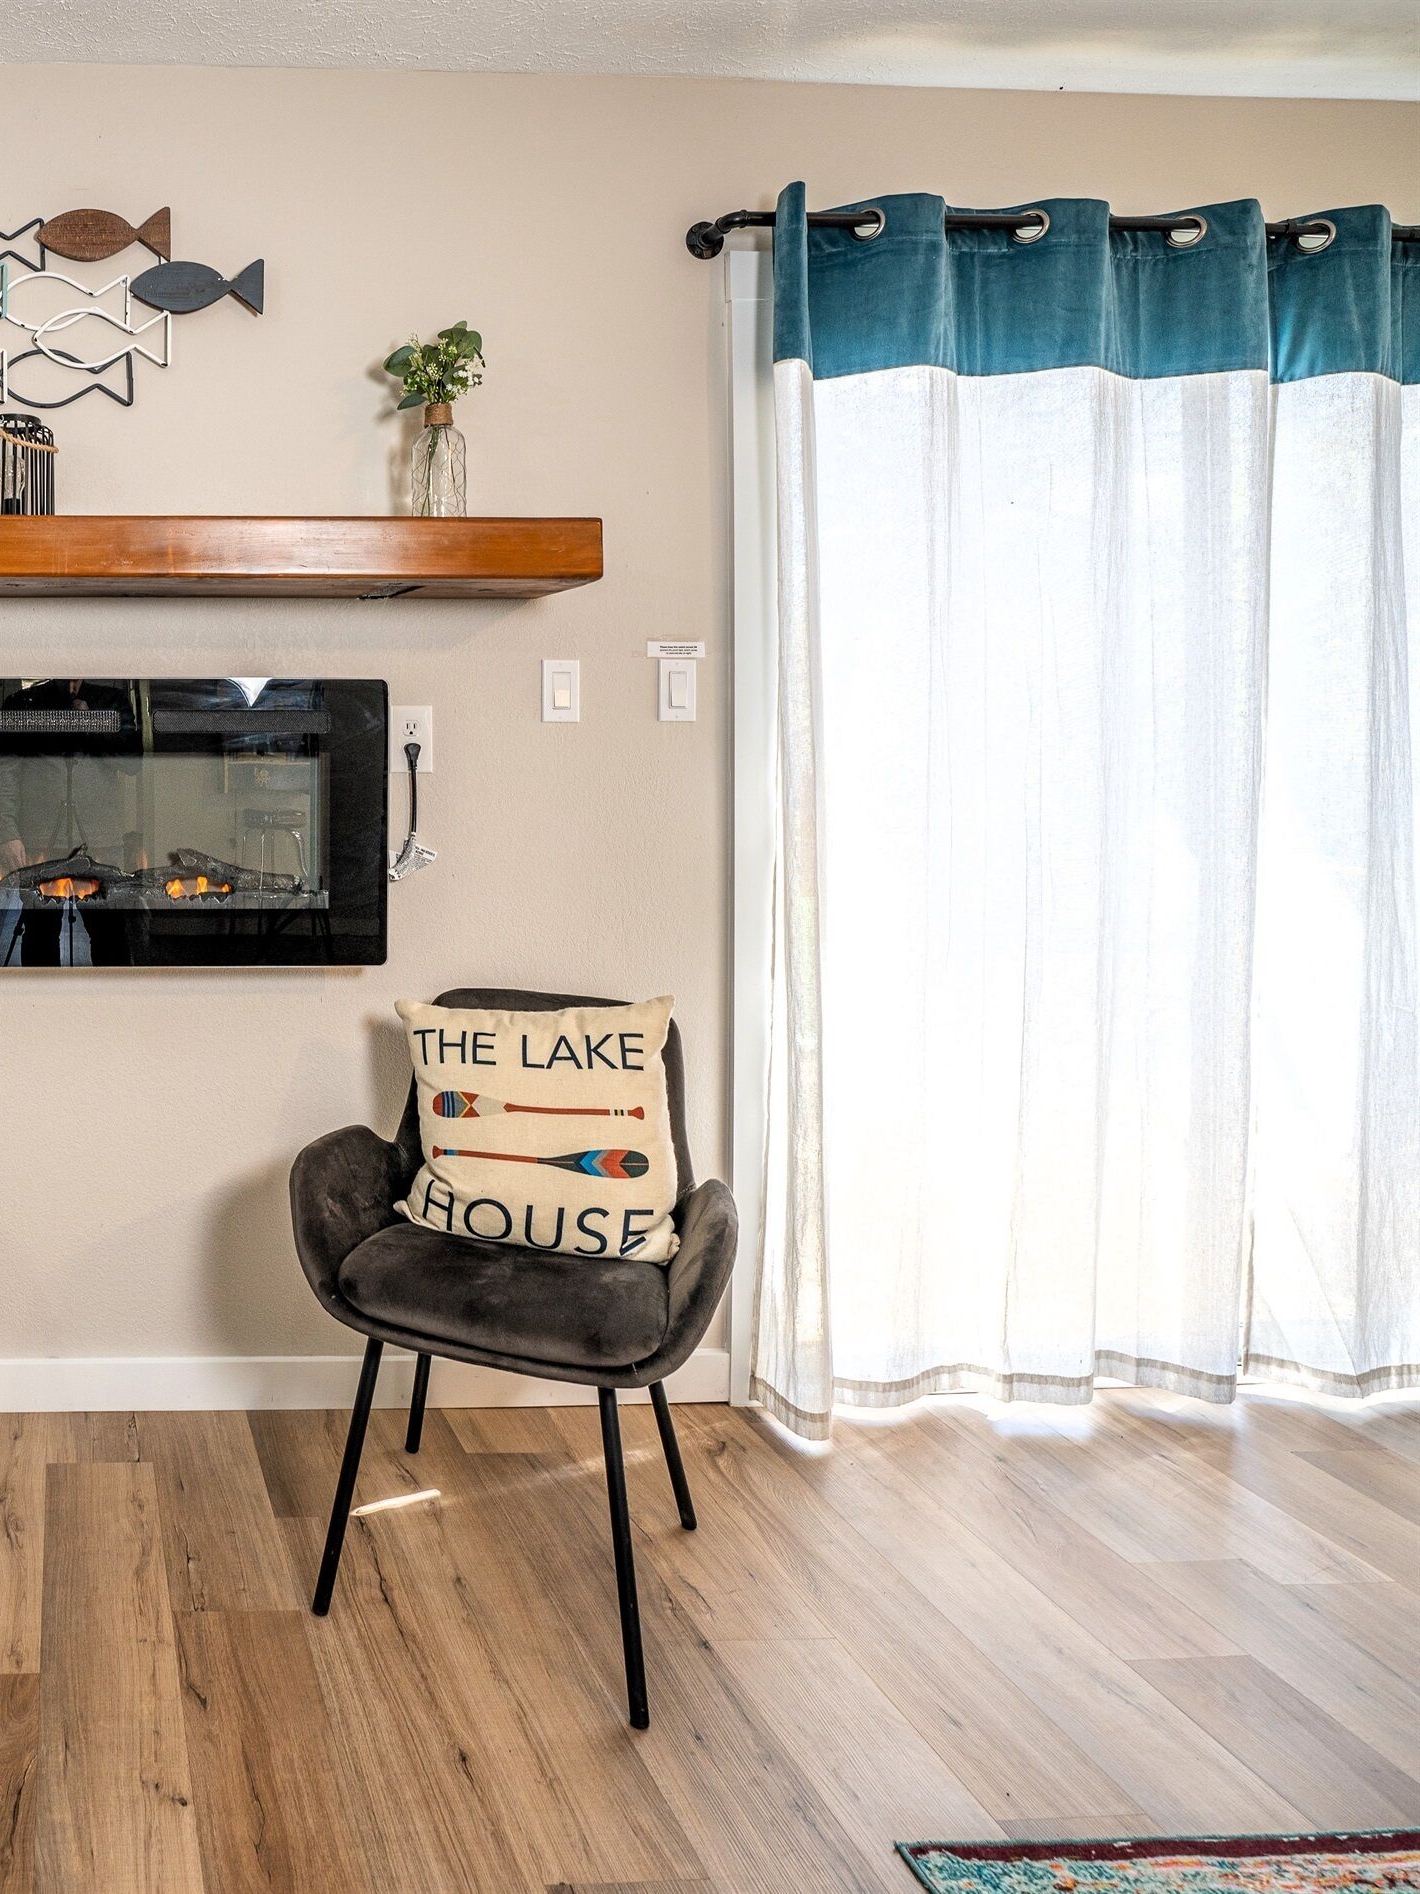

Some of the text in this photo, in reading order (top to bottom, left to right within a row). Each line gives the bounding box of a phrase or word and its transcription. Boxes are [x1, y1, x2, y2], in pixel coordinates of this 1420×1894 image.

[413, 1028, 644, 1071] THE LAKE
[422, 1179, 655, 1257] HOUSE
